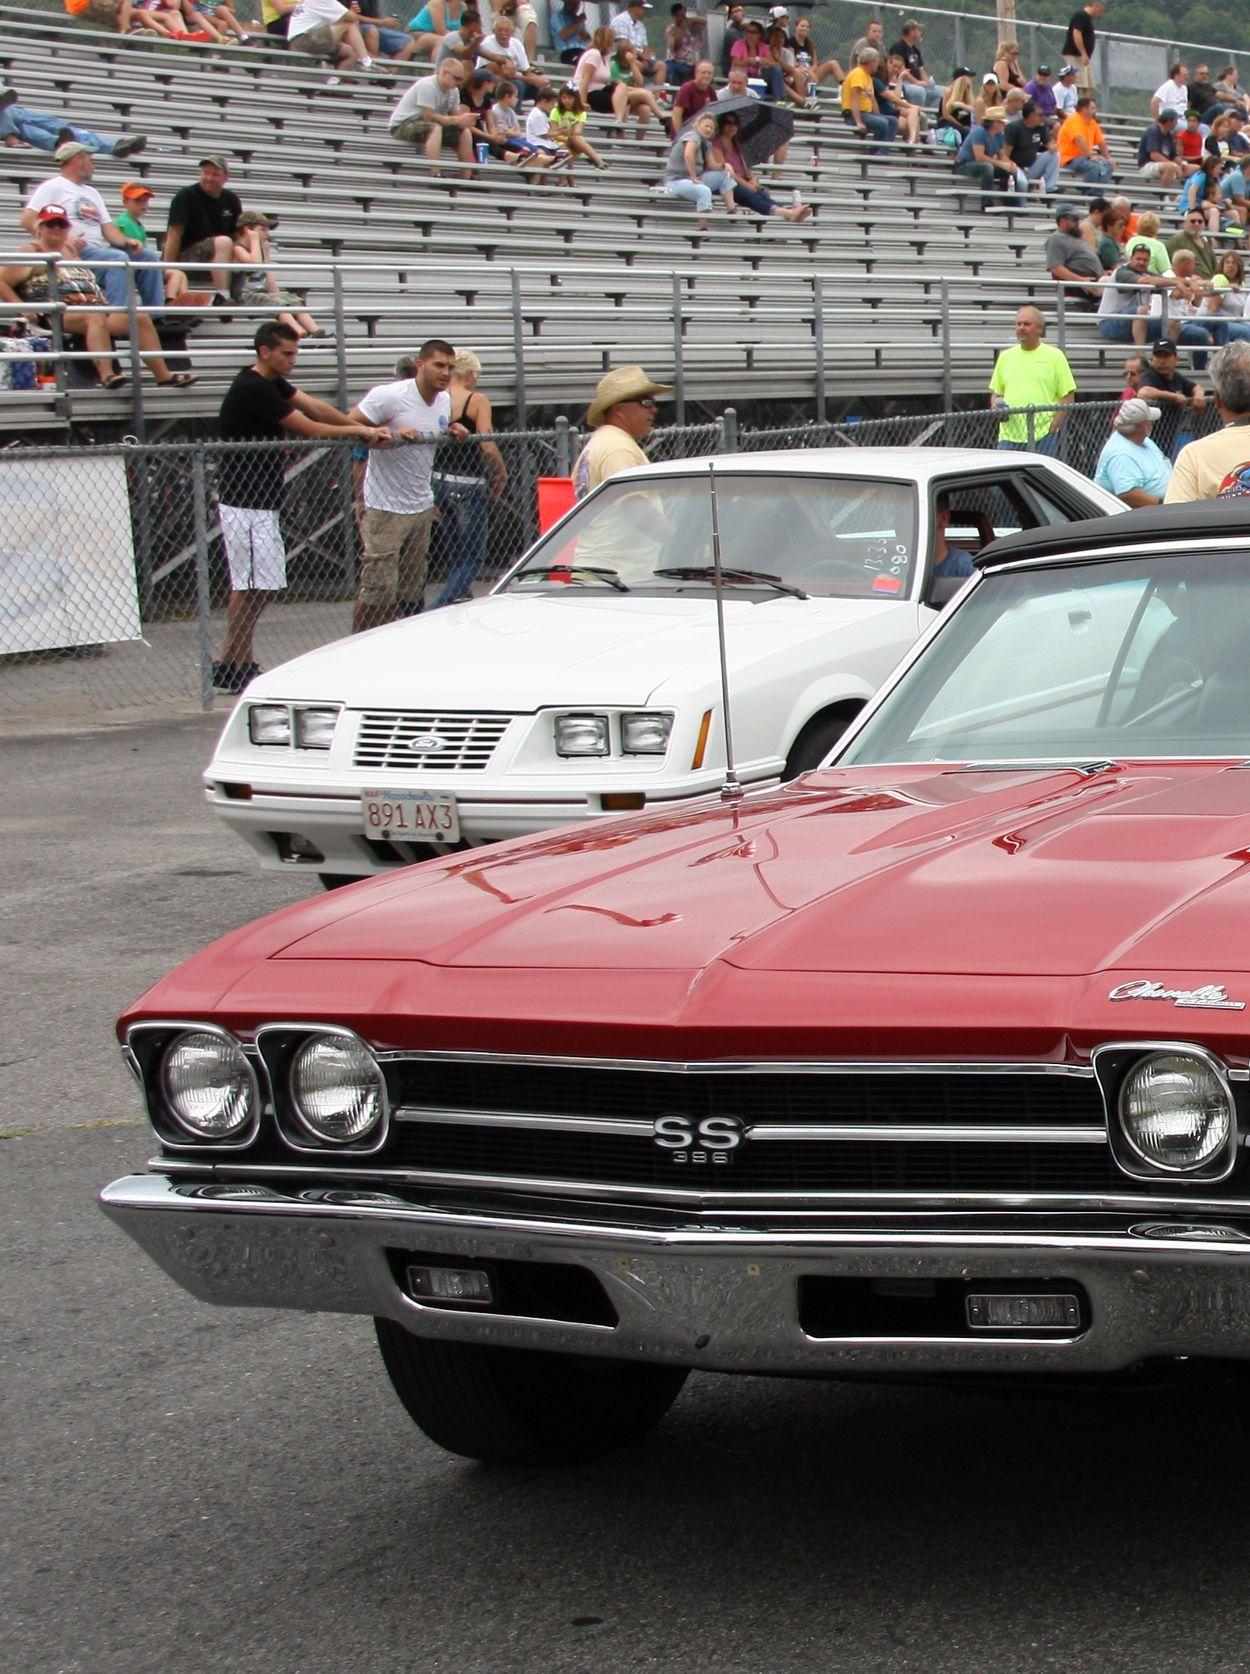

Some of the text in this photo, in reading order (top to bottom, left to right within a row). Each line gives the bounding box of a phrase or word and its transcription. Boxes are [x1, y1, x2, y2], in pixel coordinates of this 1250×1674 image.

[368, 802, 452, 829] 891 AX3
[1108, 979, 1229, 1002] Chevelle
[654, 1115, 740, 1150] SS
[671, 1150, 729, 1164] 396
